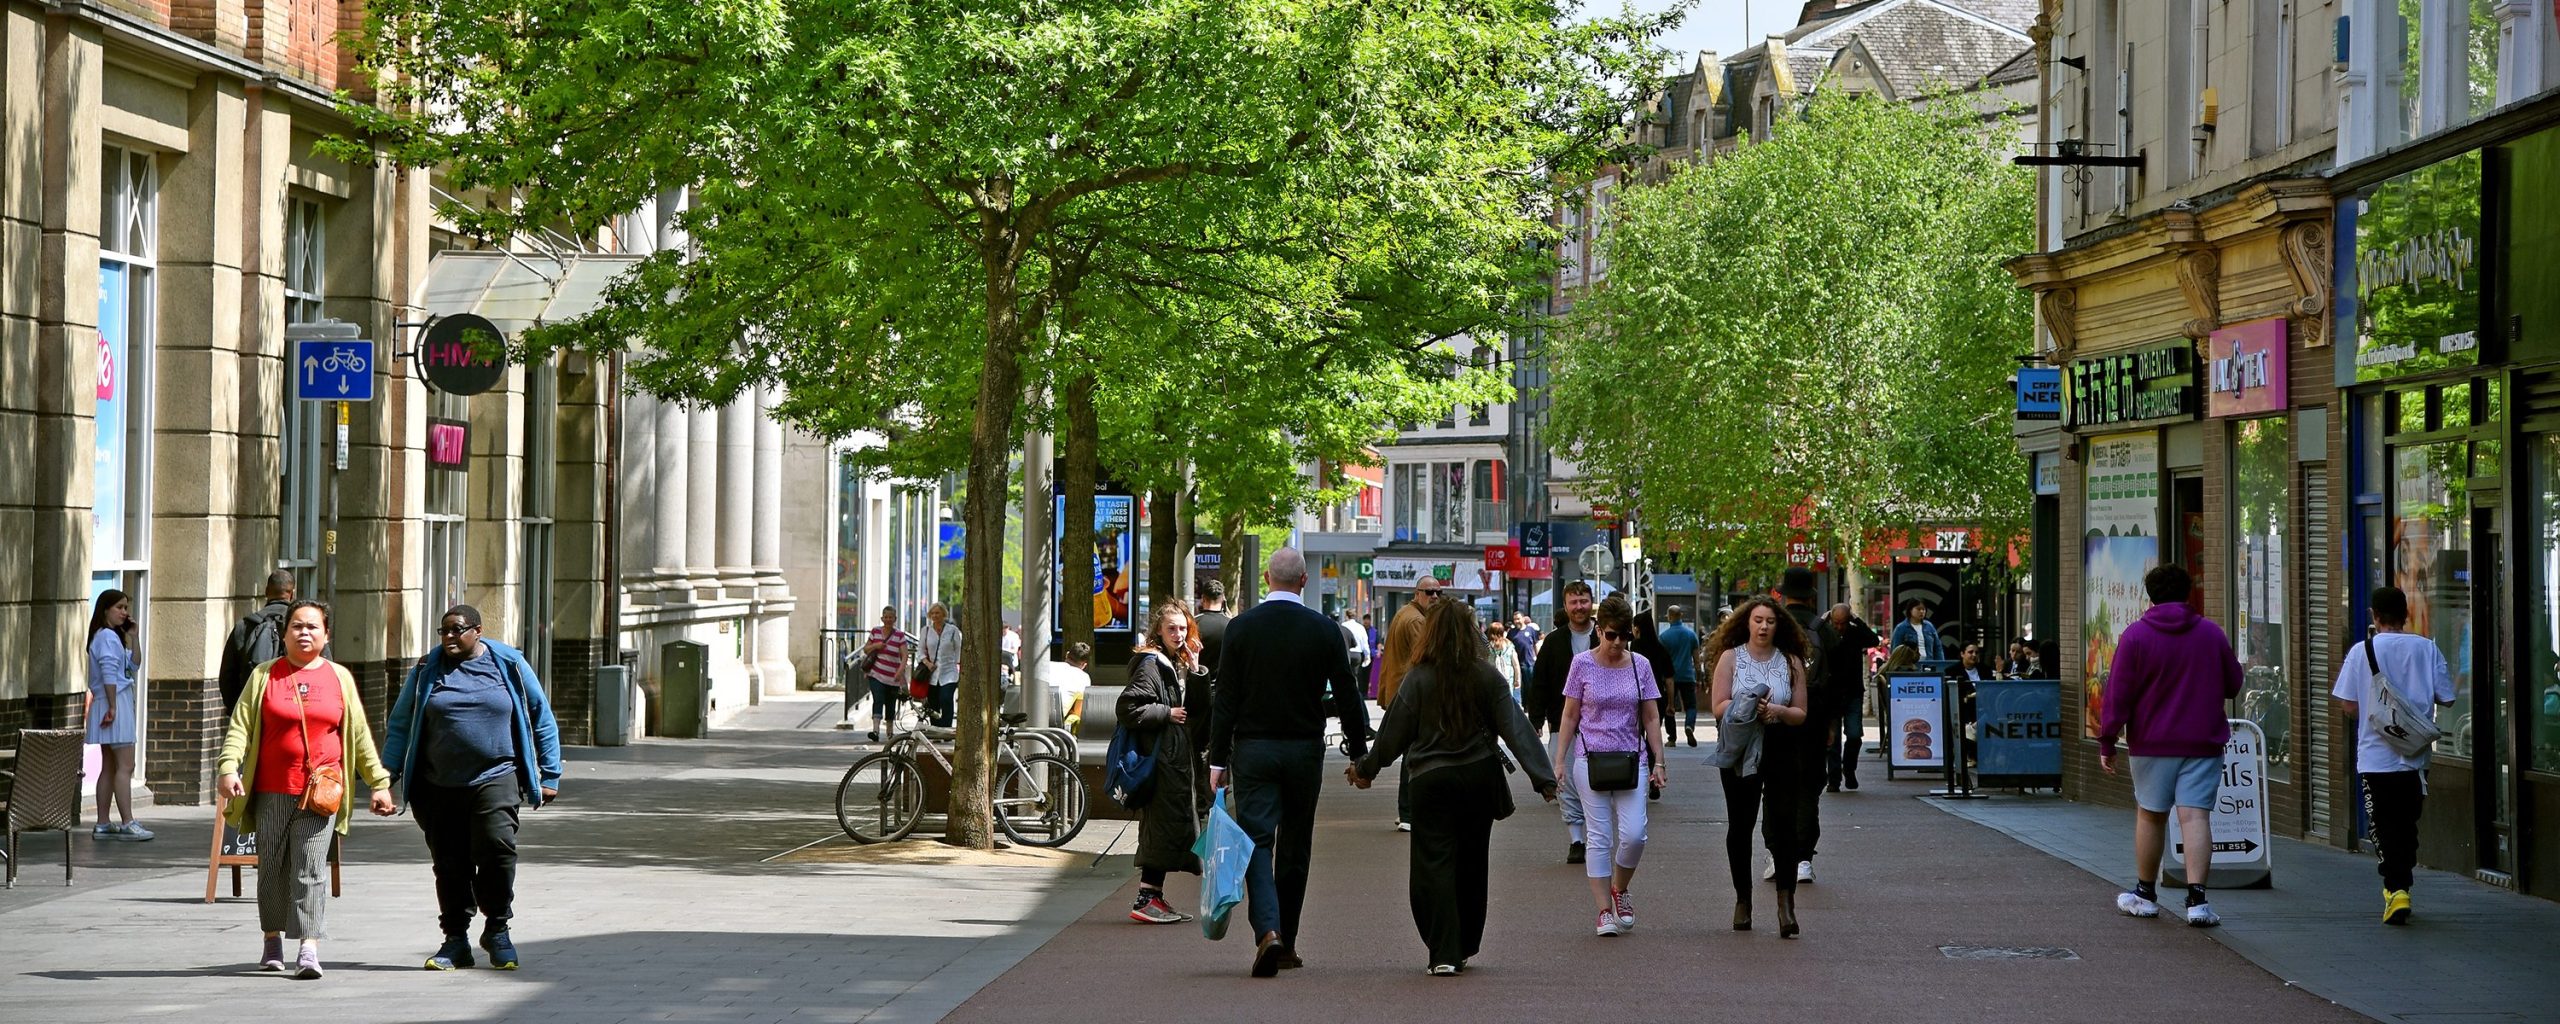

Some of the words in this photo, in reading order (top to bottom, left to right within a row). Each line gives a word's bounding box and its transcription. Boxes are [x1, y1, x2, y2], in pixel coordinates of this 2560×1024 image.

[2139, 348, 2176, 381] ORIENTAL
[2136, 387, 2182, 420] SUPERMARKET
[1897, 685, 1935, 694] NERO
[1985, 722, 2061, 739] NERO
[2222, 762, 2253, 787] ils
[2218, 795, 2254, 815] Spa
